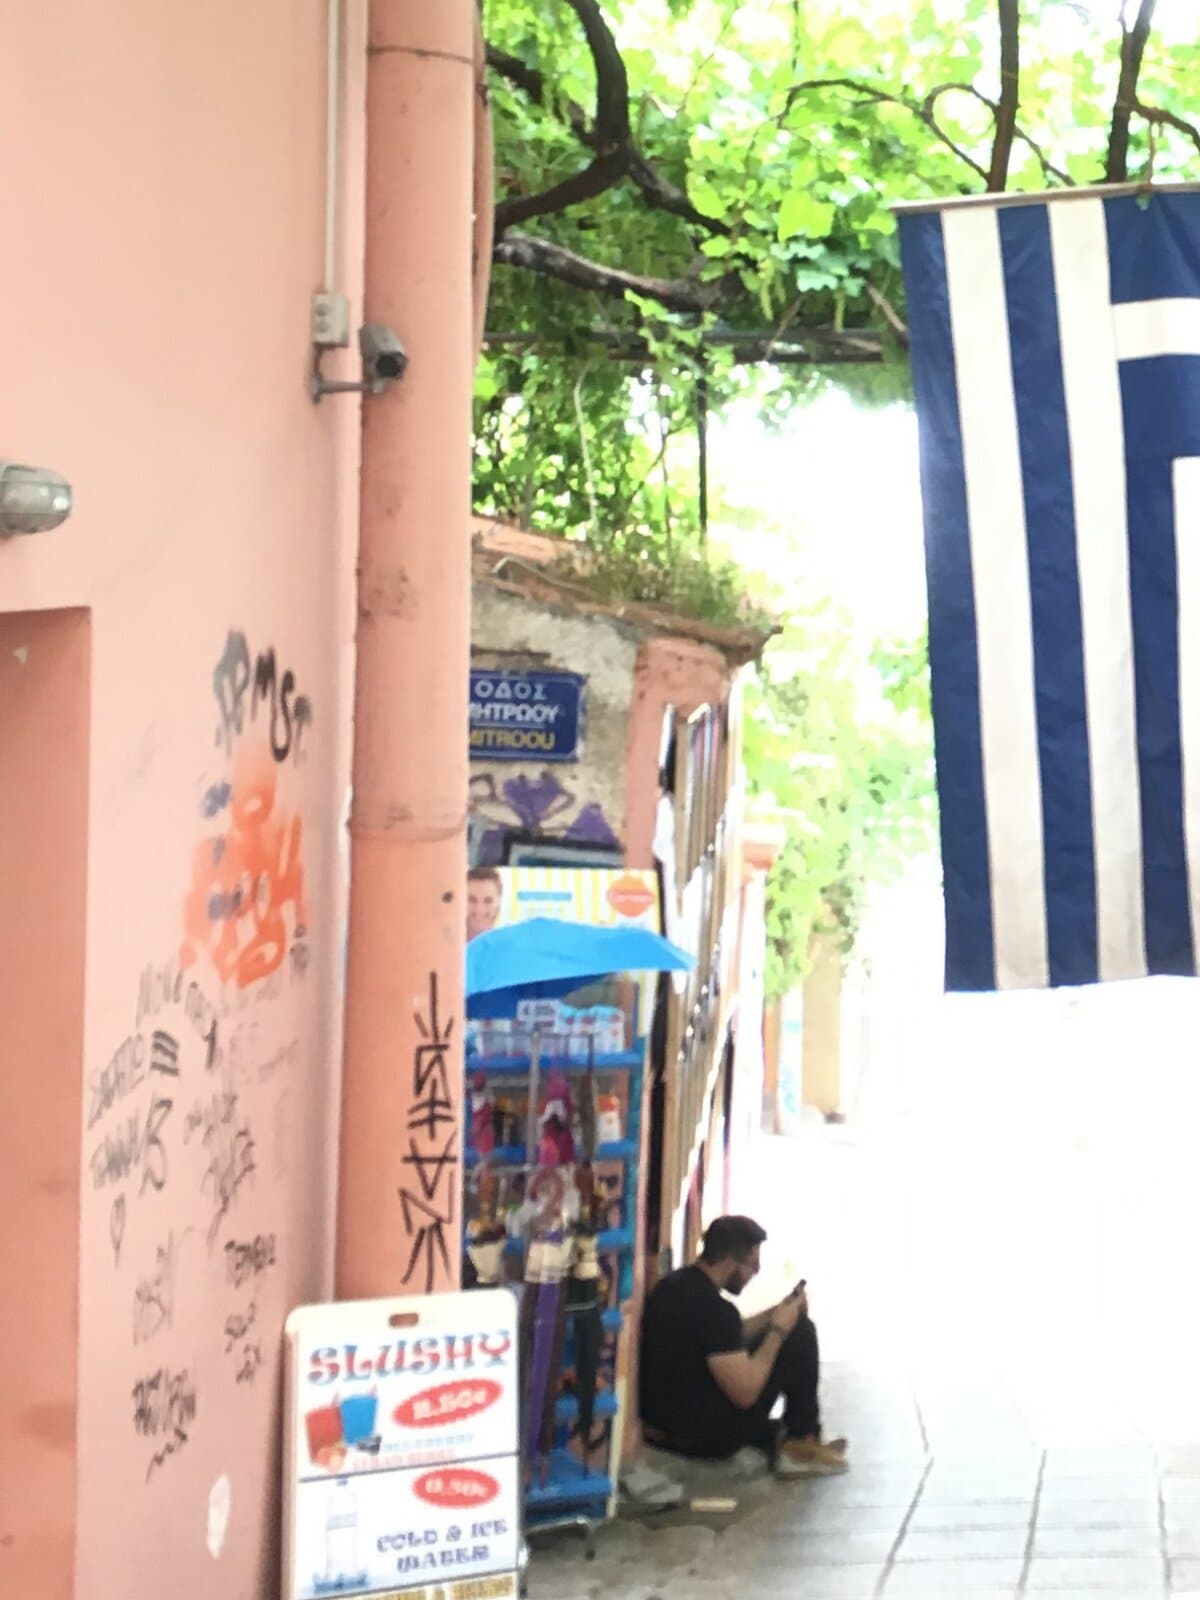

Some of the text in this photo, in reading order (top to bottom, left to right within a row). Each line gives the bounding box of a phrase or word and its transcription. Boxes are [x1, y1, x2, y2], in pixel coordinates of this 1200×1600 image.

[474, 680, 547, 700] ΟΔΟΣ
[307, 1330, 511, 1386] SLUSHY
[376, 1518, 509, 1552] COLD & ICE
